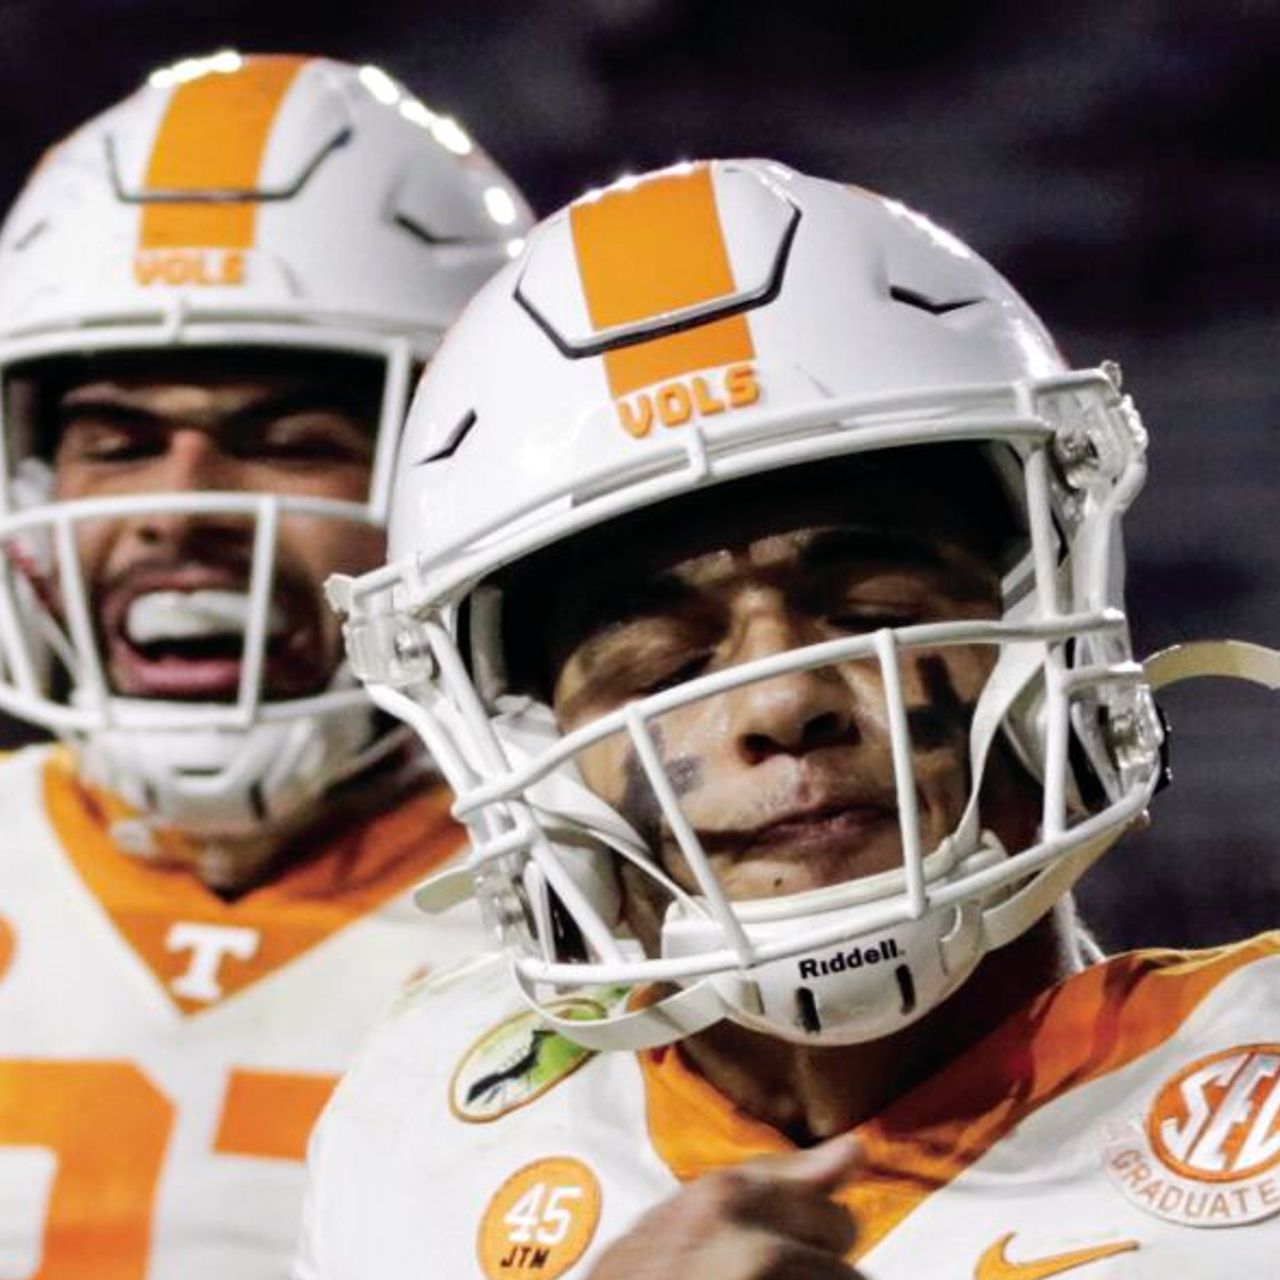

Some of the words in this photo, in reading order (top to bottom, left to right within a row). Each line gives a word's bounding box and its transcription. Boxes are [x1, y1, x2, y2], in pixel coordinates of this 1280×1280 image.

[618, 364, 761, 439] VOLS
[165, 922, 260, 1000] T
[798, 938, 899, 979] Riddell
[504, 1182, 584, 1244] 45
[499, 1245, 551, 1269] JTM
